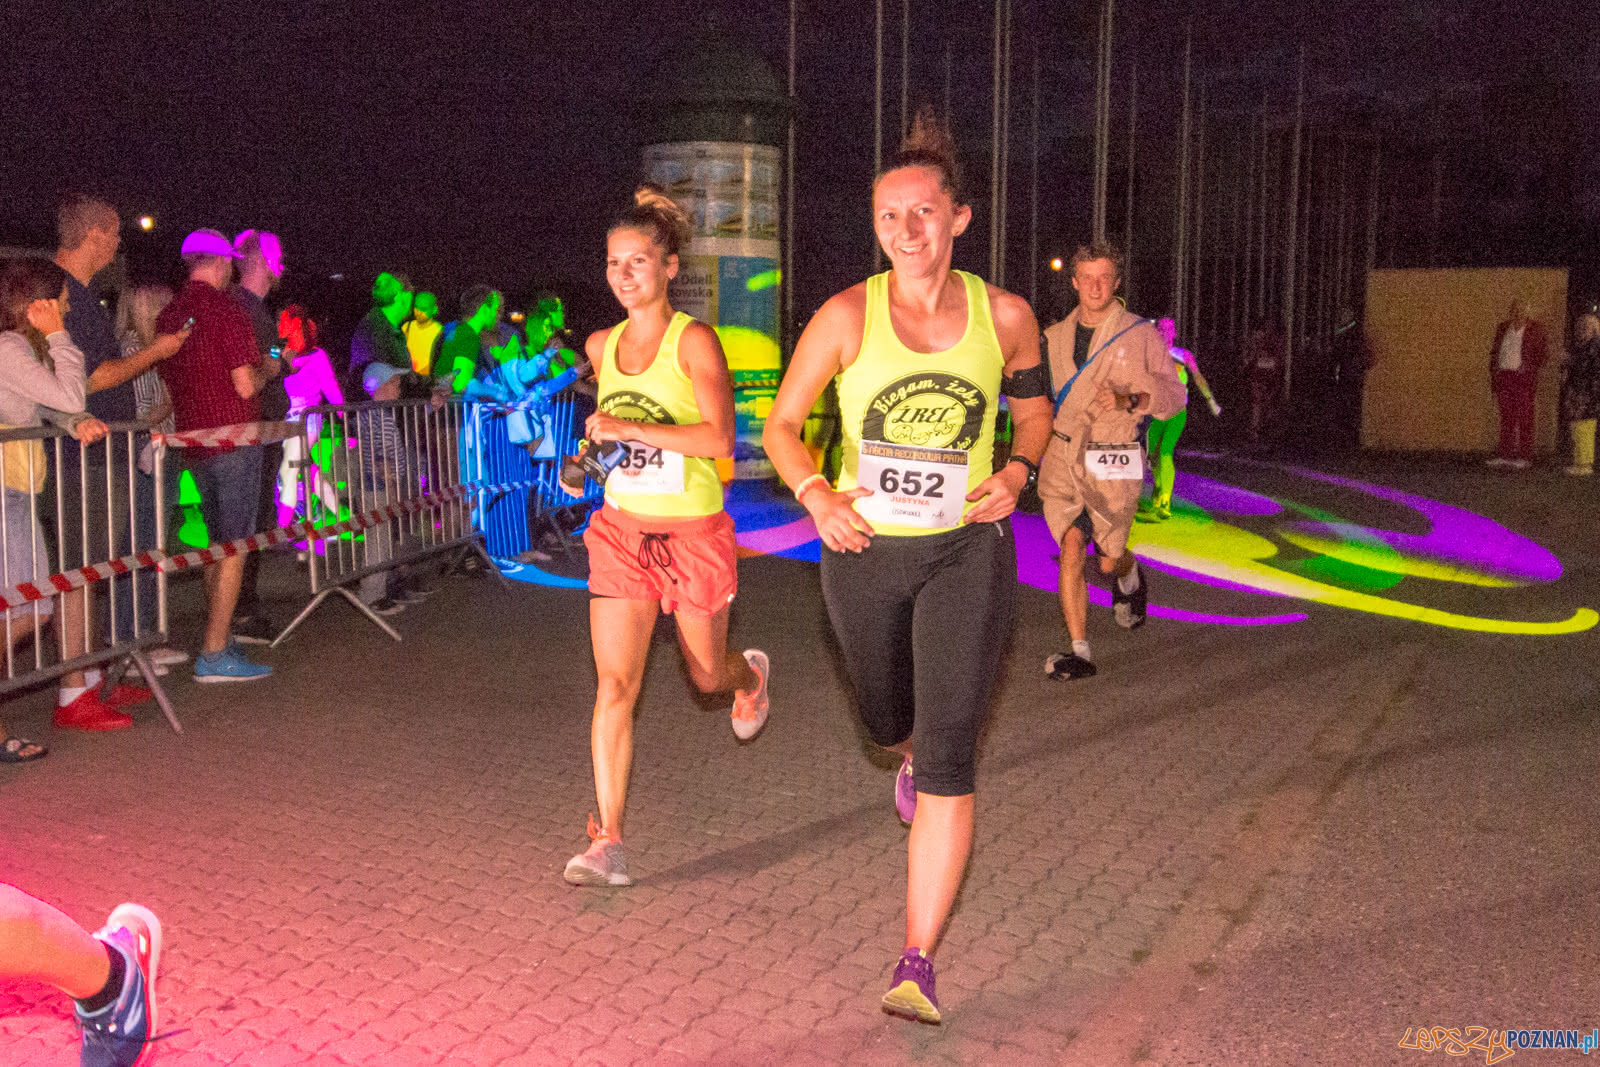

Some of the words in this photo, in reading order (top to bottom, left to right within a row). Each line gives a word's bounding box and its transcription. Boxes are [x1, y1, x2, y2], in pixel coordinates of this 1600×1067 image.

[681, 273, 713, 285] Odell
[1097, 454, 1130, 465] 470
[880, 467, 945, 498] 652
[890, 495, 930, 506] JUSTYNA
